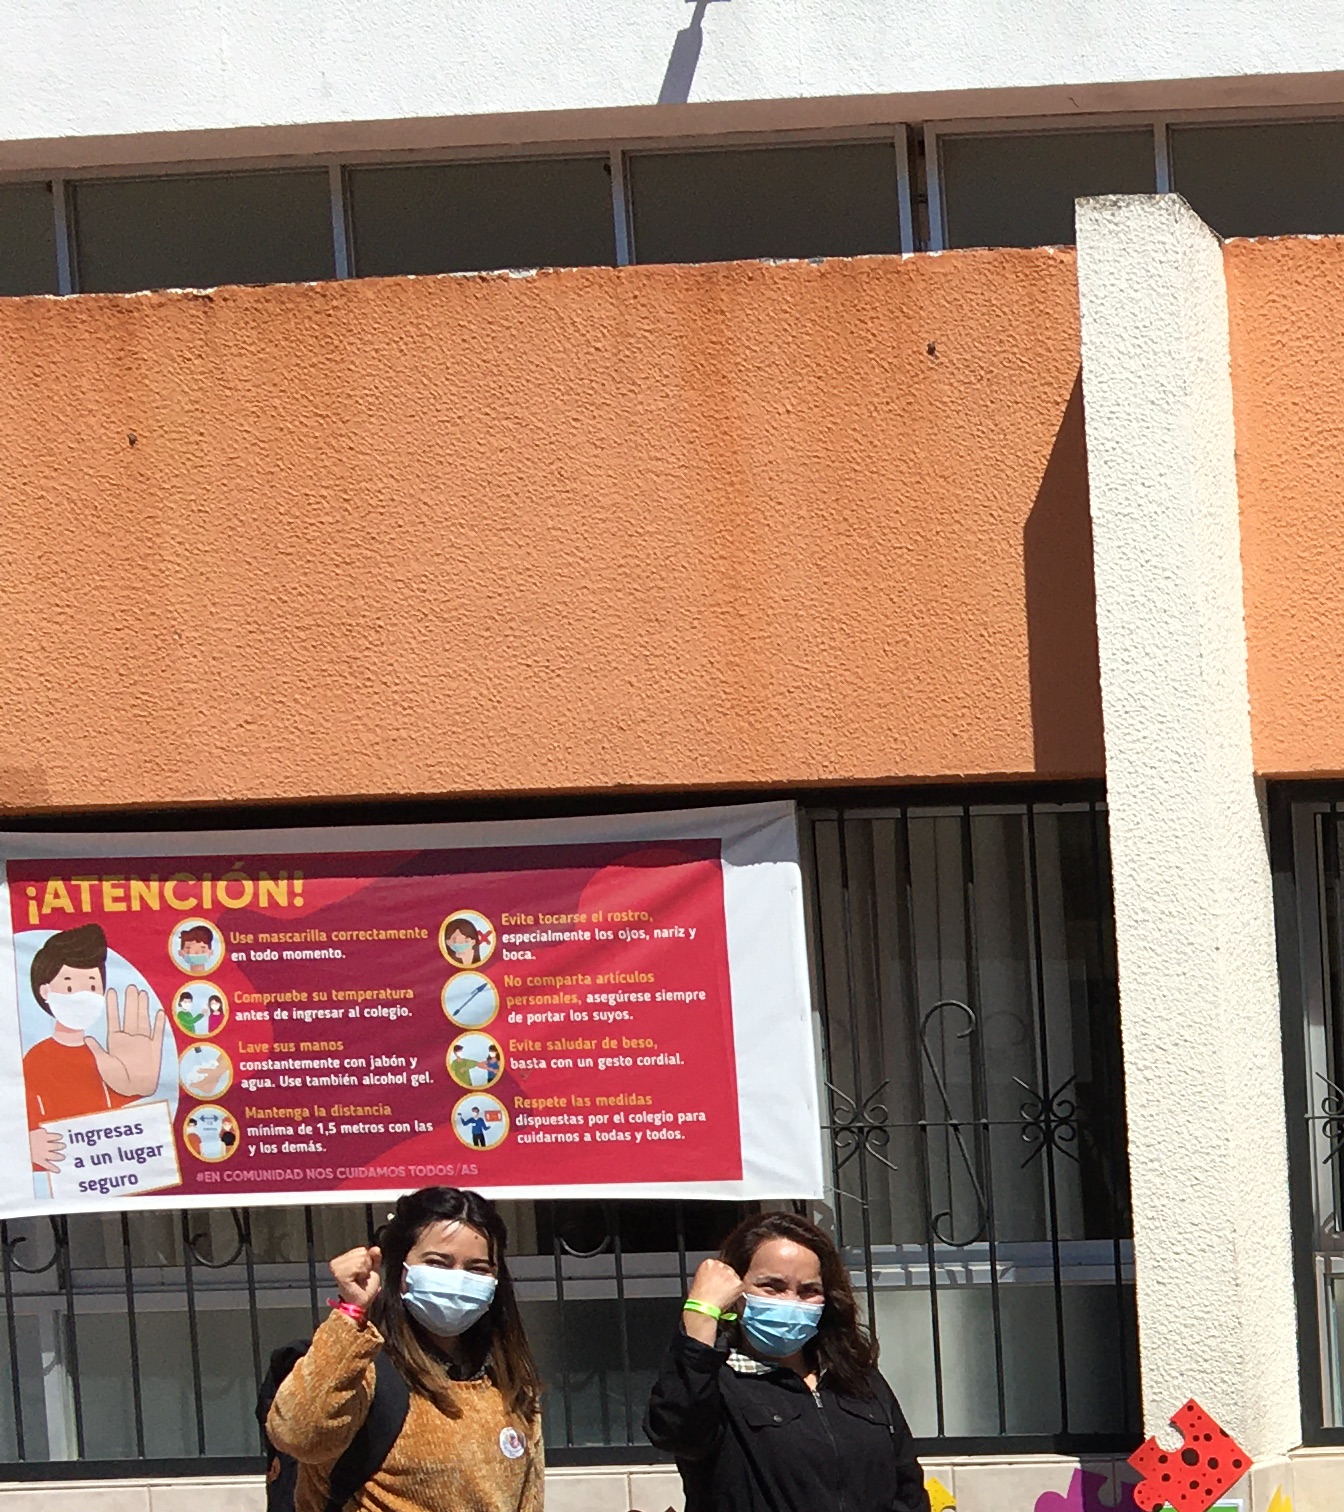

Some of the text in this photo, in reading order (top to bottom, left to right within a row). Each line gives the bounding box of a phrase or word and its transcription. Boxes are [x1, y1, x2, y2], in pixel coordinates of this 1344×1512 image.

[26, 861, 305, 925] ¡ATENCIÓN!
[501, 910, 653, 926] Evite tocarse el rostro,
[230, 926, 428, 944] Use mascarilla correctamente
[502, 929, 591, 946] especialmente
[594, 928, 614, 940] los
[618, 927, 649, 943] ojos,
[653, 925, 685, 939] nariz
[231, 948, 346, 961] en todo momento.
[502, 948, 536, 961] boca.
[504, 970, 654, 988] No comparta artículos
[234, 987, 414, 1007] Compruebe su temperatura
[506, 989, 706, 1008] personales, asegúrese siempre
[235, 1004, 413, 1023] antes de ingresar al colegio.
[508, 1009, 633, 1025] de portar los suyos.
[239, 1040, 344, 1053] Lave sus manos
[509, 1036, 658, 1052] Evite saludar de beso,
[239, 1058, 340, 1071] constantemente
[344, 1058, 365, 1068] con
[369, 1054, 406, 1070] jabón
[510, 1053, 684, 1071] basta con un gesto cordial.
[241, 1072, 433, 1091] agua. Use también alcohol gel.
[514, 1093, 652, 1109] Respete las medidas
[245, 1103, 392, 1121] Mantenga la distancia
[516, 1110, 706, 1128] dispuestas por el colegio para
[68, 1121, 144, 1146] ingresas
[247, 1119, 433, 1137] mínima de 1,5 metros con las
[517, 1130, 579, 1143] cuidarnos
[595, 1130, 631, 1141] todas
[646, 1128, 685, 1140] todos.
[90, 1153, 113, 1167] un
[118, 1142, 164, 1167] lugar
[260, 1141, 277, 1153] los
[281, 1139, 326, 1153] demás.
[223, 1168, 301, 1181] COMUNIDAD
[306, 1167, 334, 1180] NOS
[336, 1165, 405, 1179] CUIDAMOS
[78, 1172, 139, 1195] seguro
